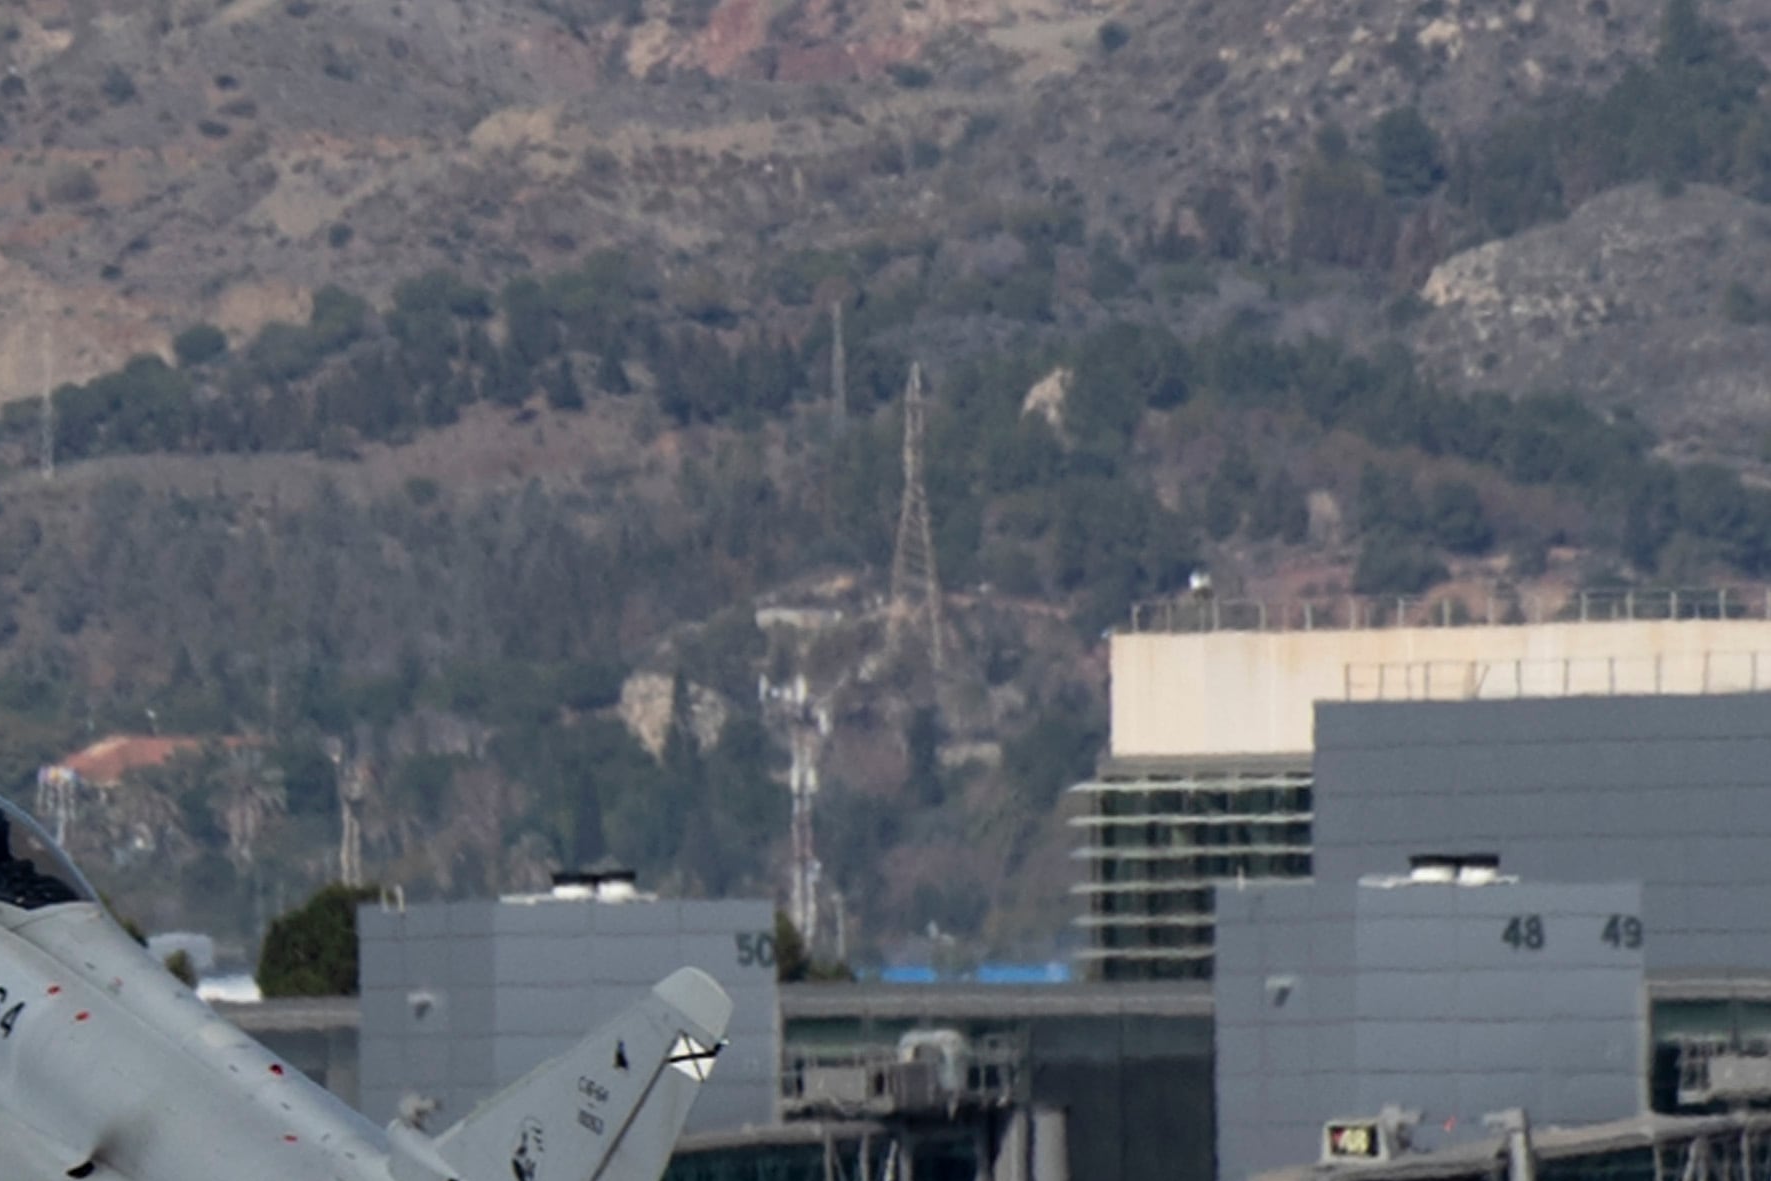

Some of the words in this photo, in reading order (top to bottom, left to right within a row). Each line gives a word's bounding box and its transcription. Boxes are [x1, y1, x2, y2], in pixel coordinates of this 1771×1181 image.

[1502, 914, 1545, 950] 48
[1602, 913, 1644, 950] 49
[736, 932, 775, 968] 50
